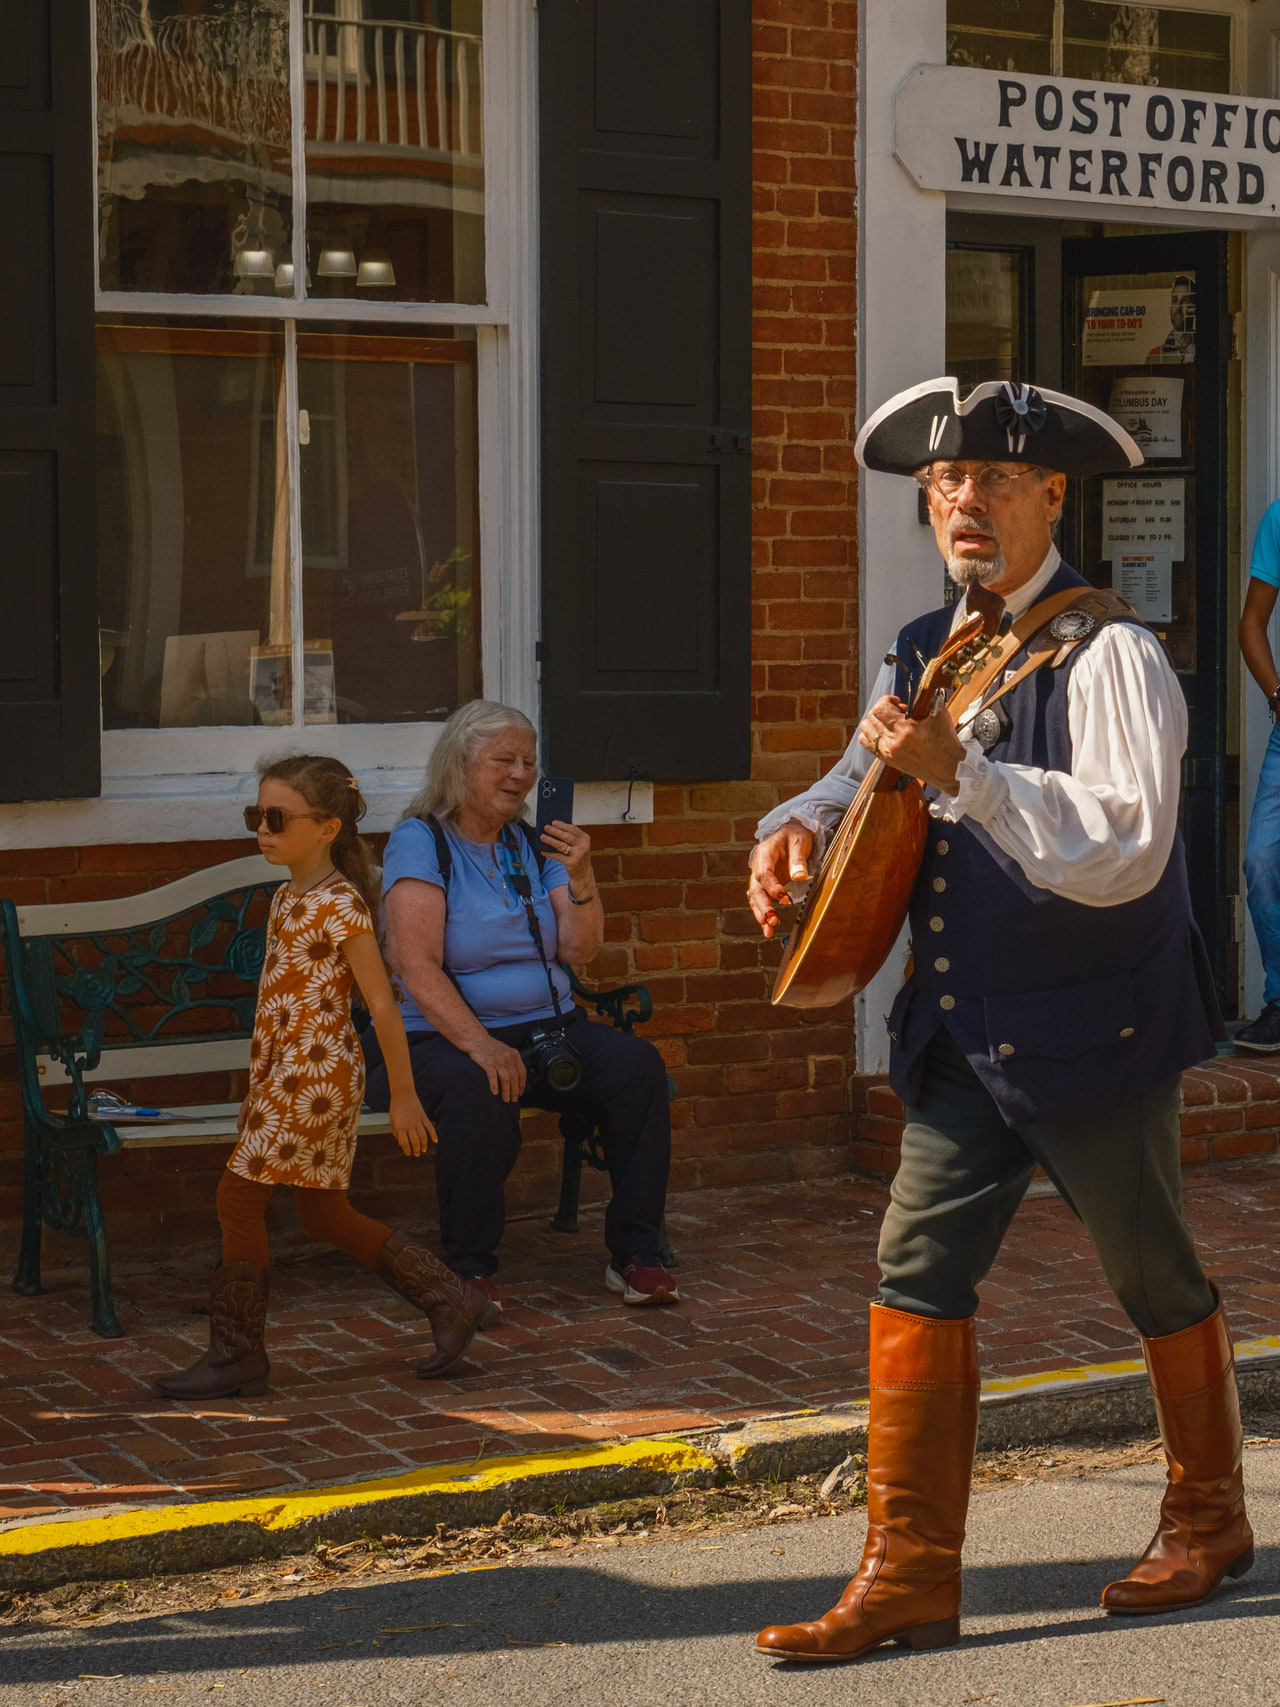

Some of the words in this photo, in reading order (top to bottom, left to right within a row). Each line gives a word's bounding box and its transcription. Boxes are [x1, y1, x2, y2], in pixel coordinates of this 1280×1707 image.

[997, 79, 1130, 137] POST
[954, 136, 1277, 212] WATERFORD,
[1085, 306, 1119, 317] BRINGING
[1120, 305, 1146, 316] CAN-DO
[1086, 319, 1096, 330] TO
[1097, 319, 1115, 329] YOUR
[1116, 318, 1143, 329] TO-DO'S
[1112, 398, 1150, 408] COLUMBUS
[1151, 397, 1168, 407] DAY
